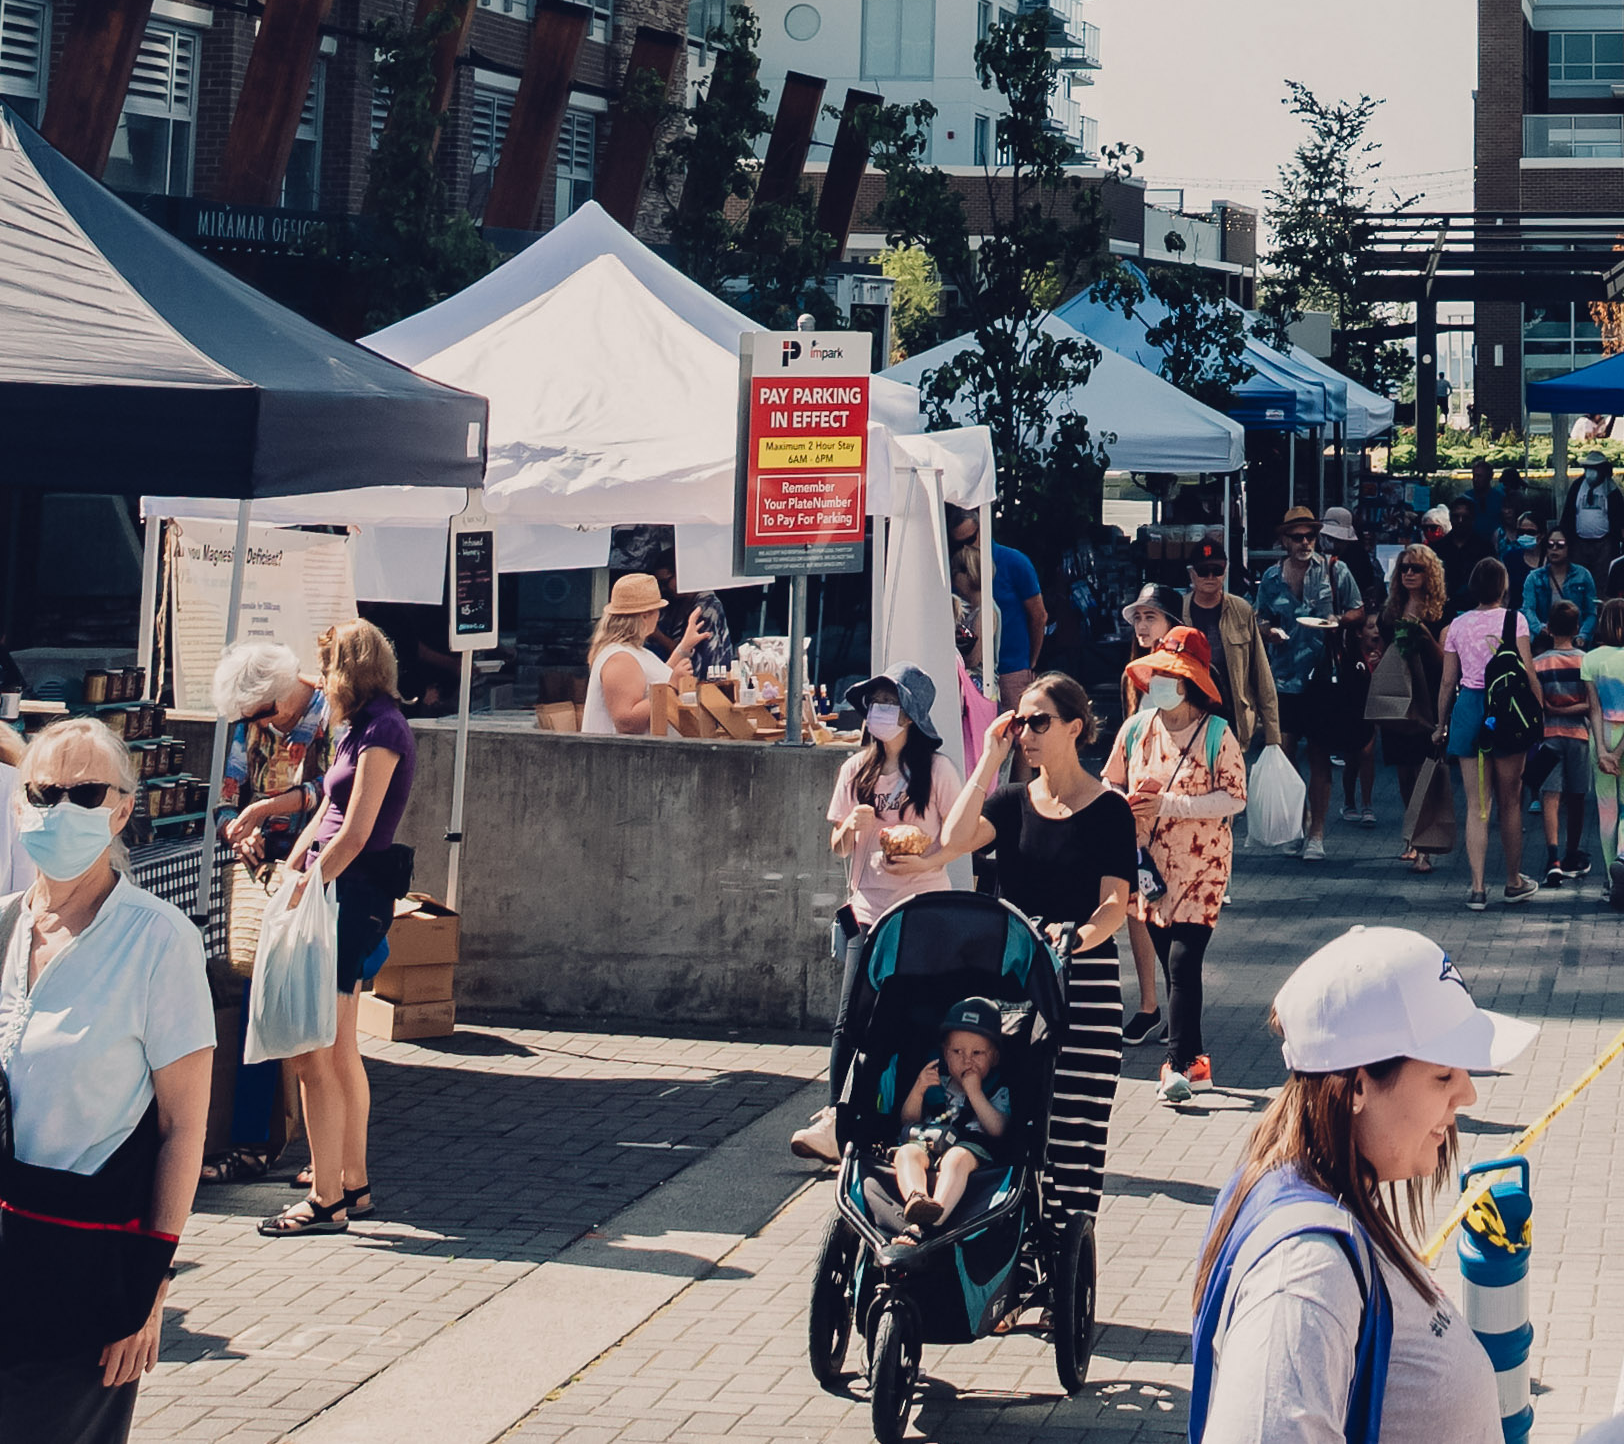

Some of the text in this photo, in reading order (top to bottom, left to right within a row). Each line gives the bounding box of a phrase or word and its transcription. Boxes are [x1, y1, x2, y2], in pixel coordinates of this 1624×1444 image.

[198, 210, 265, 240] MIRAMAR
[810, 346, 844, 361] impark
[759, 387, 862, 405] PAY PARKING
[770, 410, 850, 429] IN EFFECT
[765, 441, 855, 452] Maximum 2 Hour Stay
[788, 454, 808, 463] 6AM
[815, 454, 834, 463] 6PM
[782, 480, 836, 493] Remember
[764, 498, 787, 510] Your
[762, 511, 853, 528] To Pay For Parking
